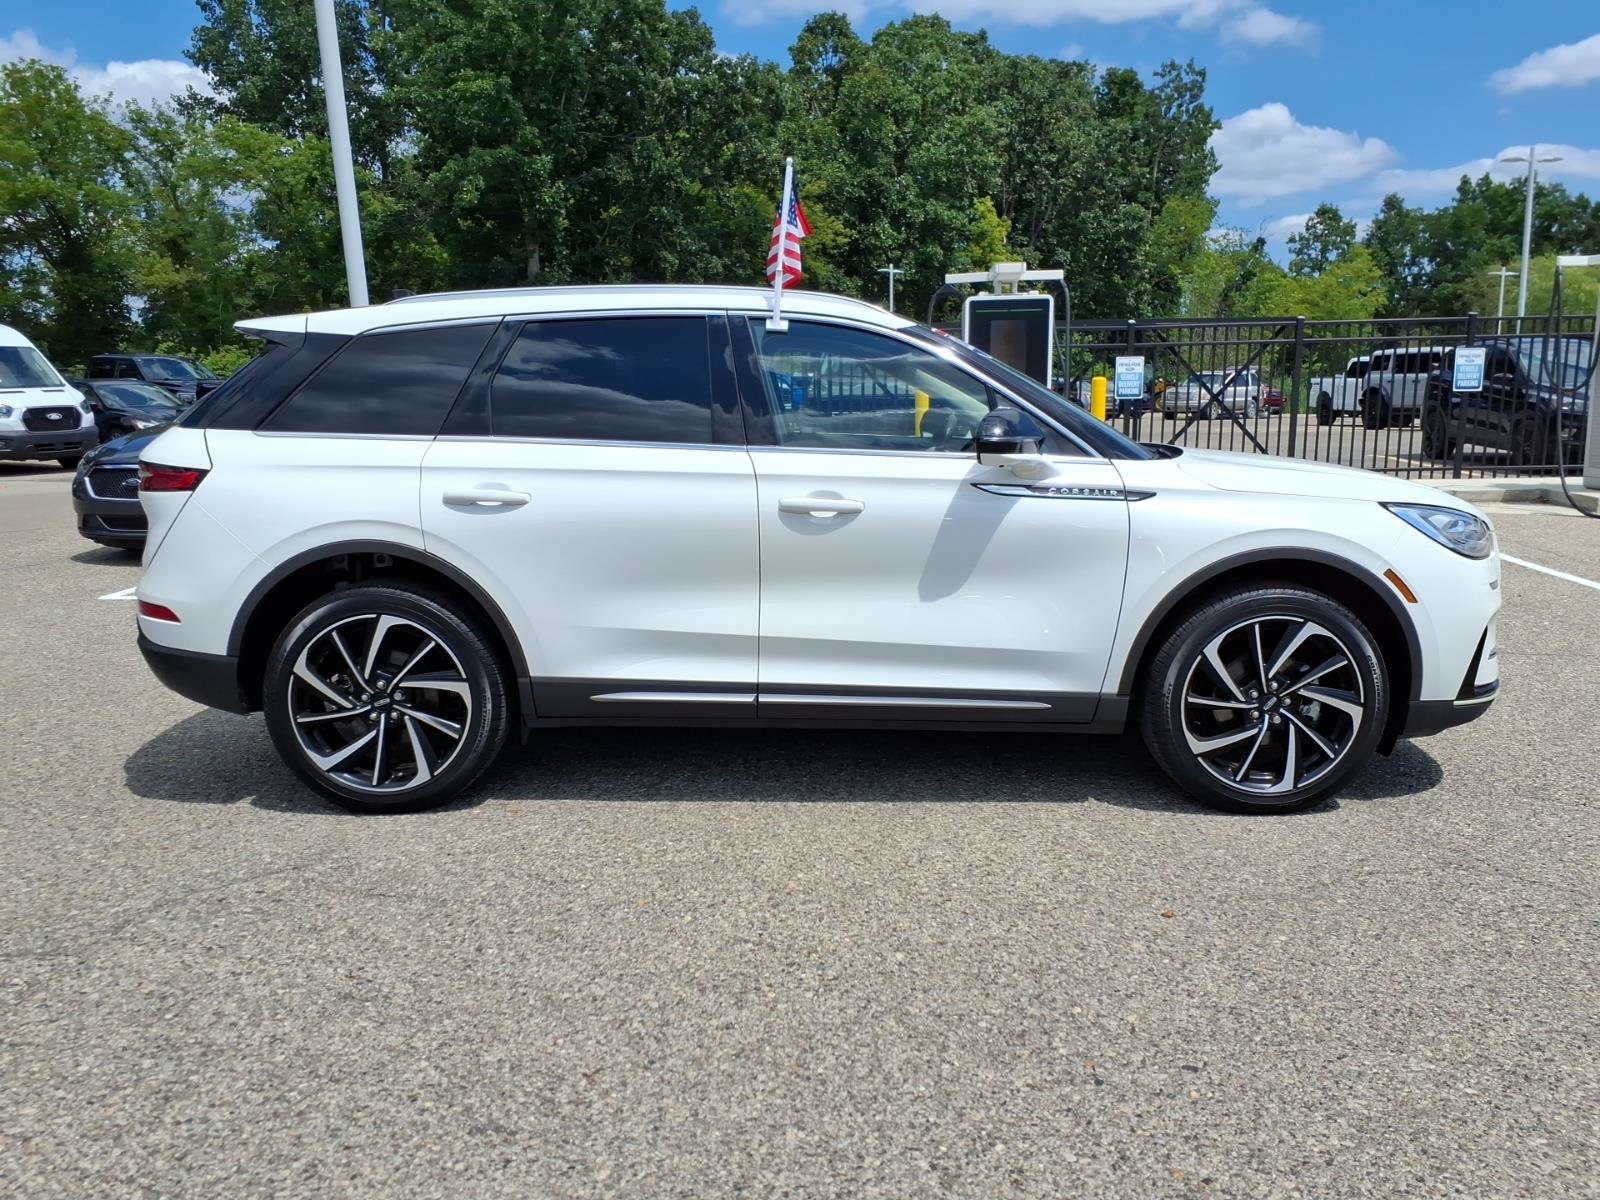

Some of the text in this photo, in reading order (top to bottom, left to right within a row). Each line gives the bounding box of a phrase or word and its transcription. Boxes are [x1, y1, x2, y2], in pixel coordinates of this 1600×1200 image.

[1457, 365, 1479, 373] VEHICLE
[1119, 373, 1139, 381] VEHICLE
[1118, 380, 1141, 388] DELIVERY
[1457, 379, 1479, 387] PARKING
[1118, 387, 1140, 395] PARKING
[1048, 487, 1118, 497] CORSAIR
